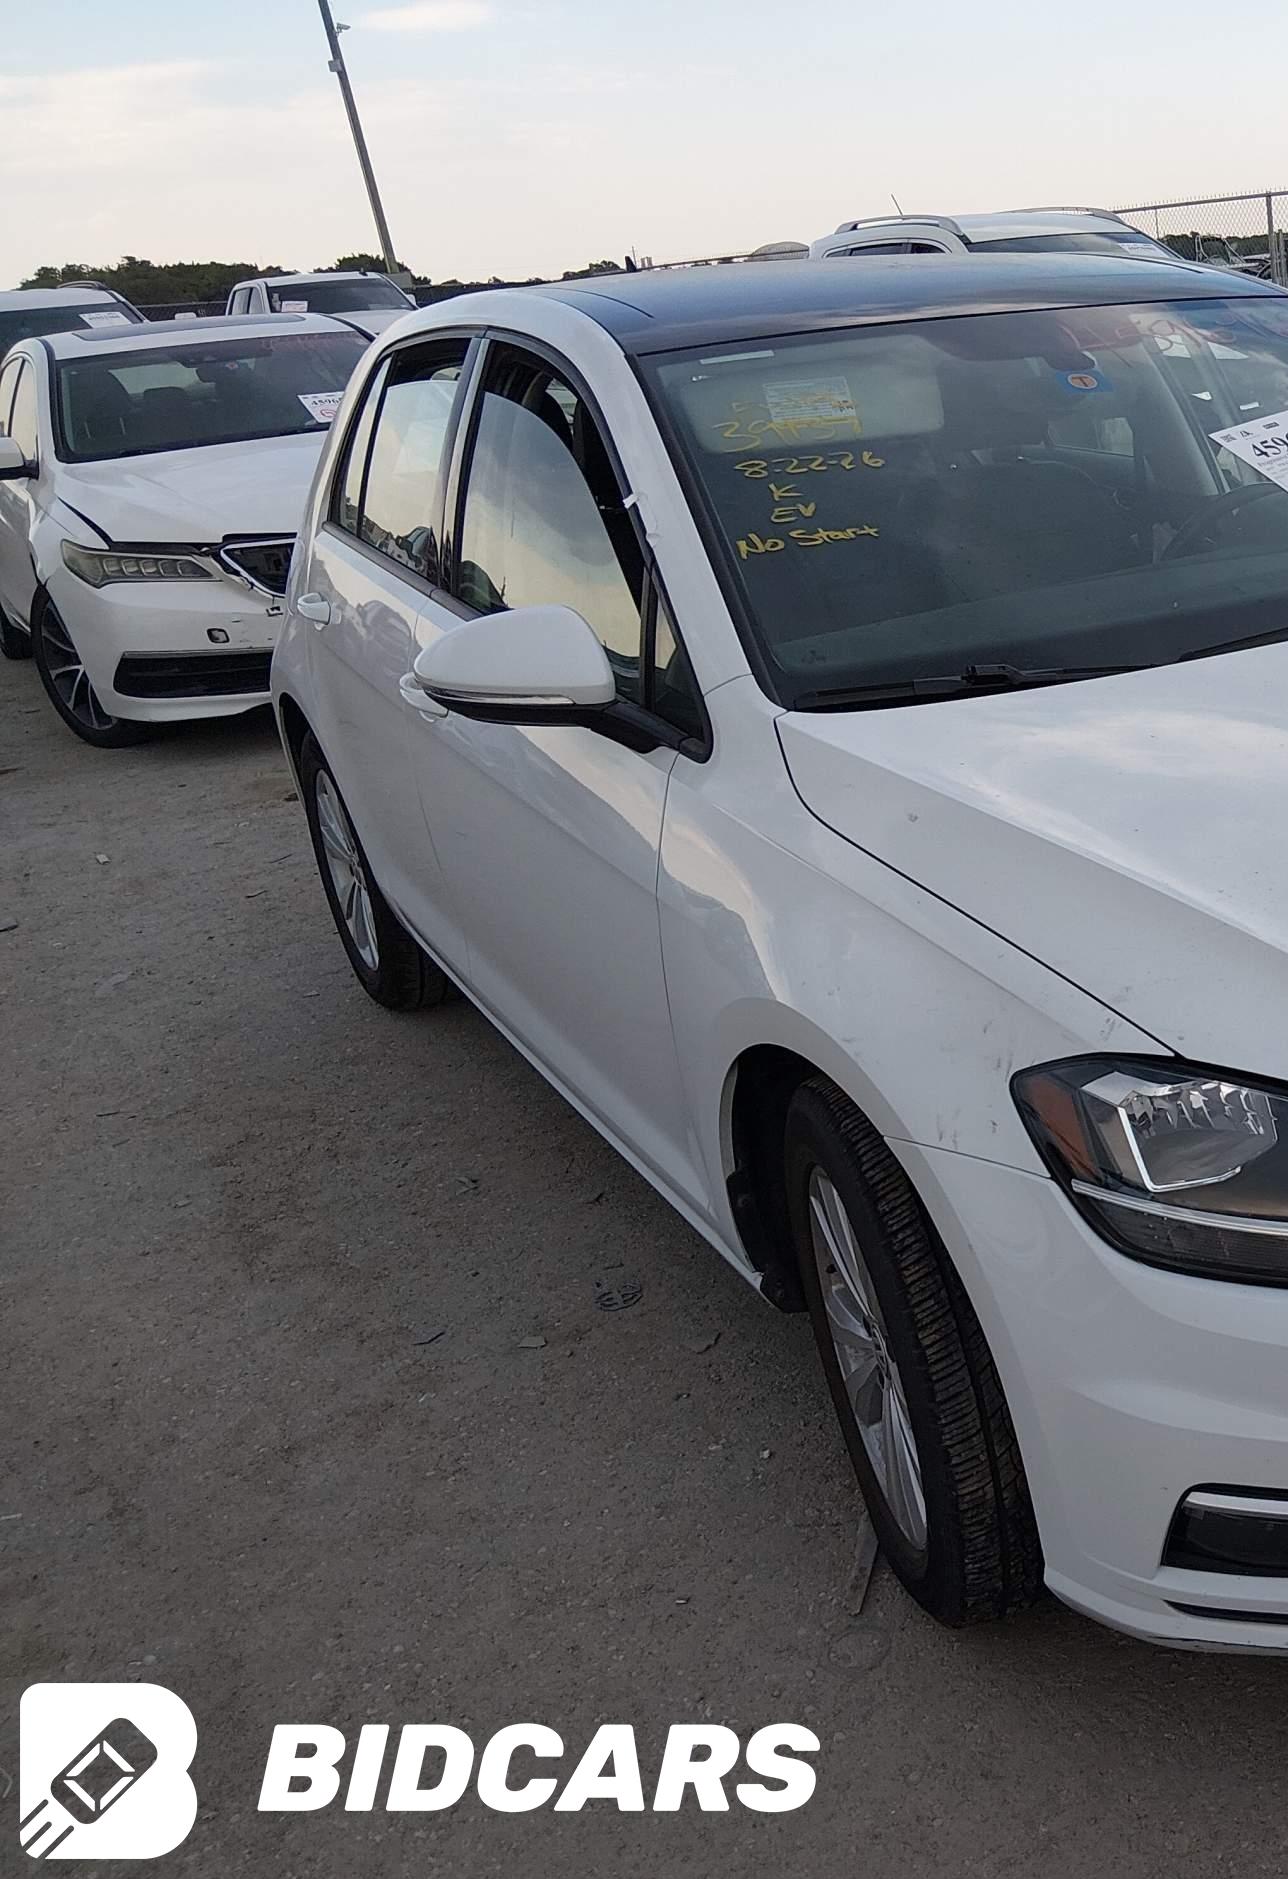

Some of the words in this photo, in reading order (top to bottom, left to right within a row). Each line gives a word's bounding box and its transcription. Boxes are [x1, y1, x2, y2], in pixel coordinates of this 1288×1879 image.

[768, 483, 804, 501] K
[771, 502, 816, 523] EV
[736, 533, 785, 560] No
[789, 524, 880, 546] Start
